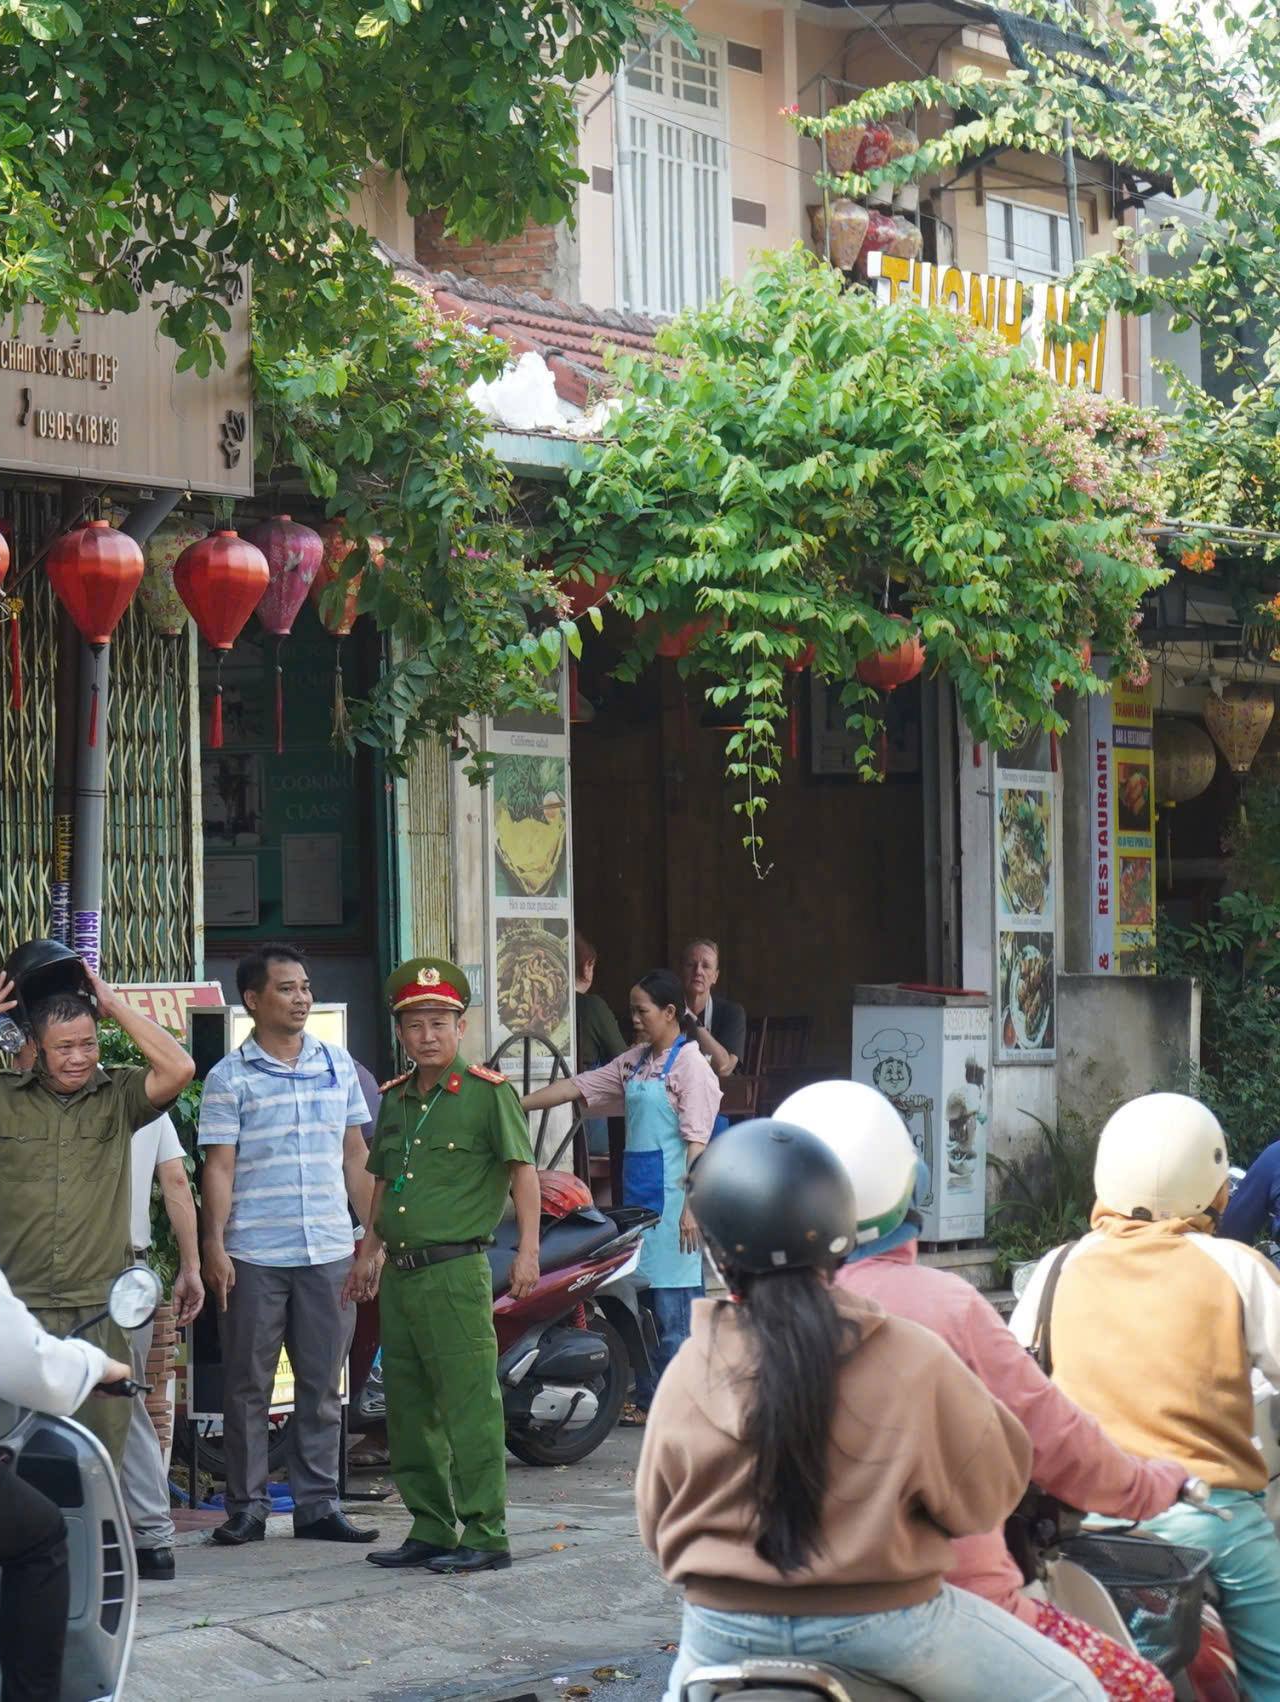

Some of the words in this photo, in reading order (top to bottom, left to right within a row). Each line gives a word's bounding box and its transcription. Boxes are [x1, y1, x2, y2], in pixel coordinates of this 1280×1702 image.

[285, 803, 342, 820] CLASS
[1097, 739, 1109, 914] RESTAURANT
[1098, 952, 1109, 970] &
